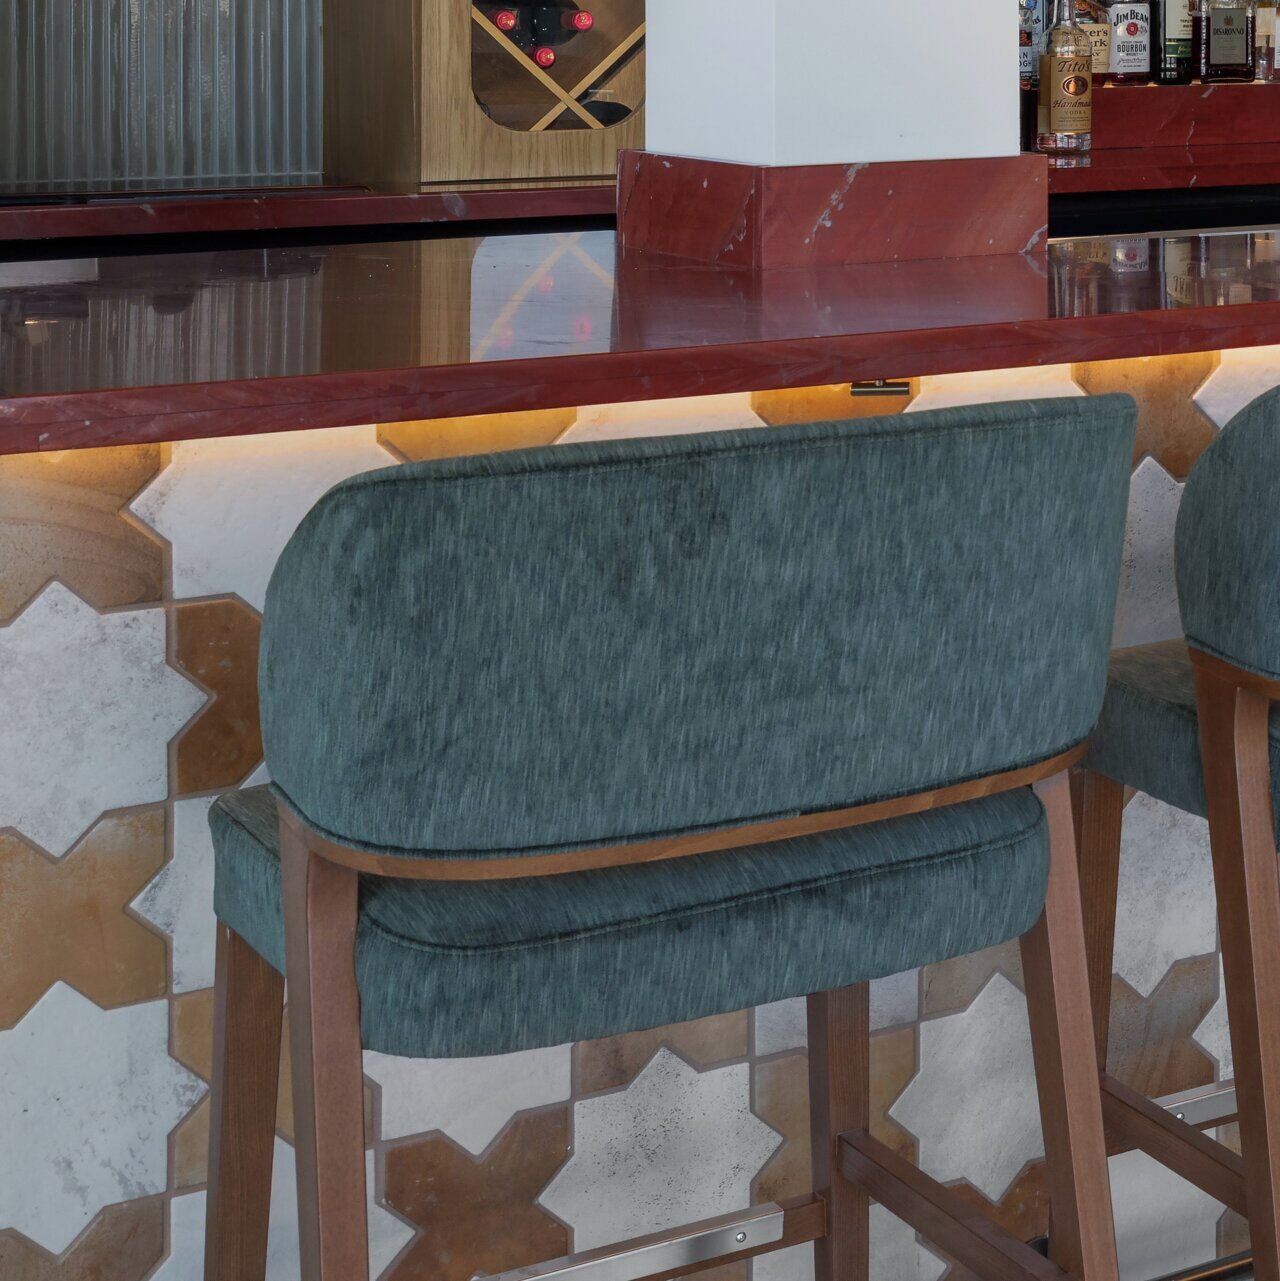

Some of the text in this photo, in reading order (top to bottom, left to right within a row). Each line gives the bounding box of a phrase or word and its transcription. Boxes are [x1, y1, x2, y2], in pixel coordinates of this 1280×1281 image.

[1113, 9, 1149, 27] JIM BEAM
[1213, 27, 1245, 36] DISARONNO
[1116, 43, 1147, 53] BOURBON
[1057, 58, 1092, 73] Tito's
[1052, 96, 1092, 109] Handma
